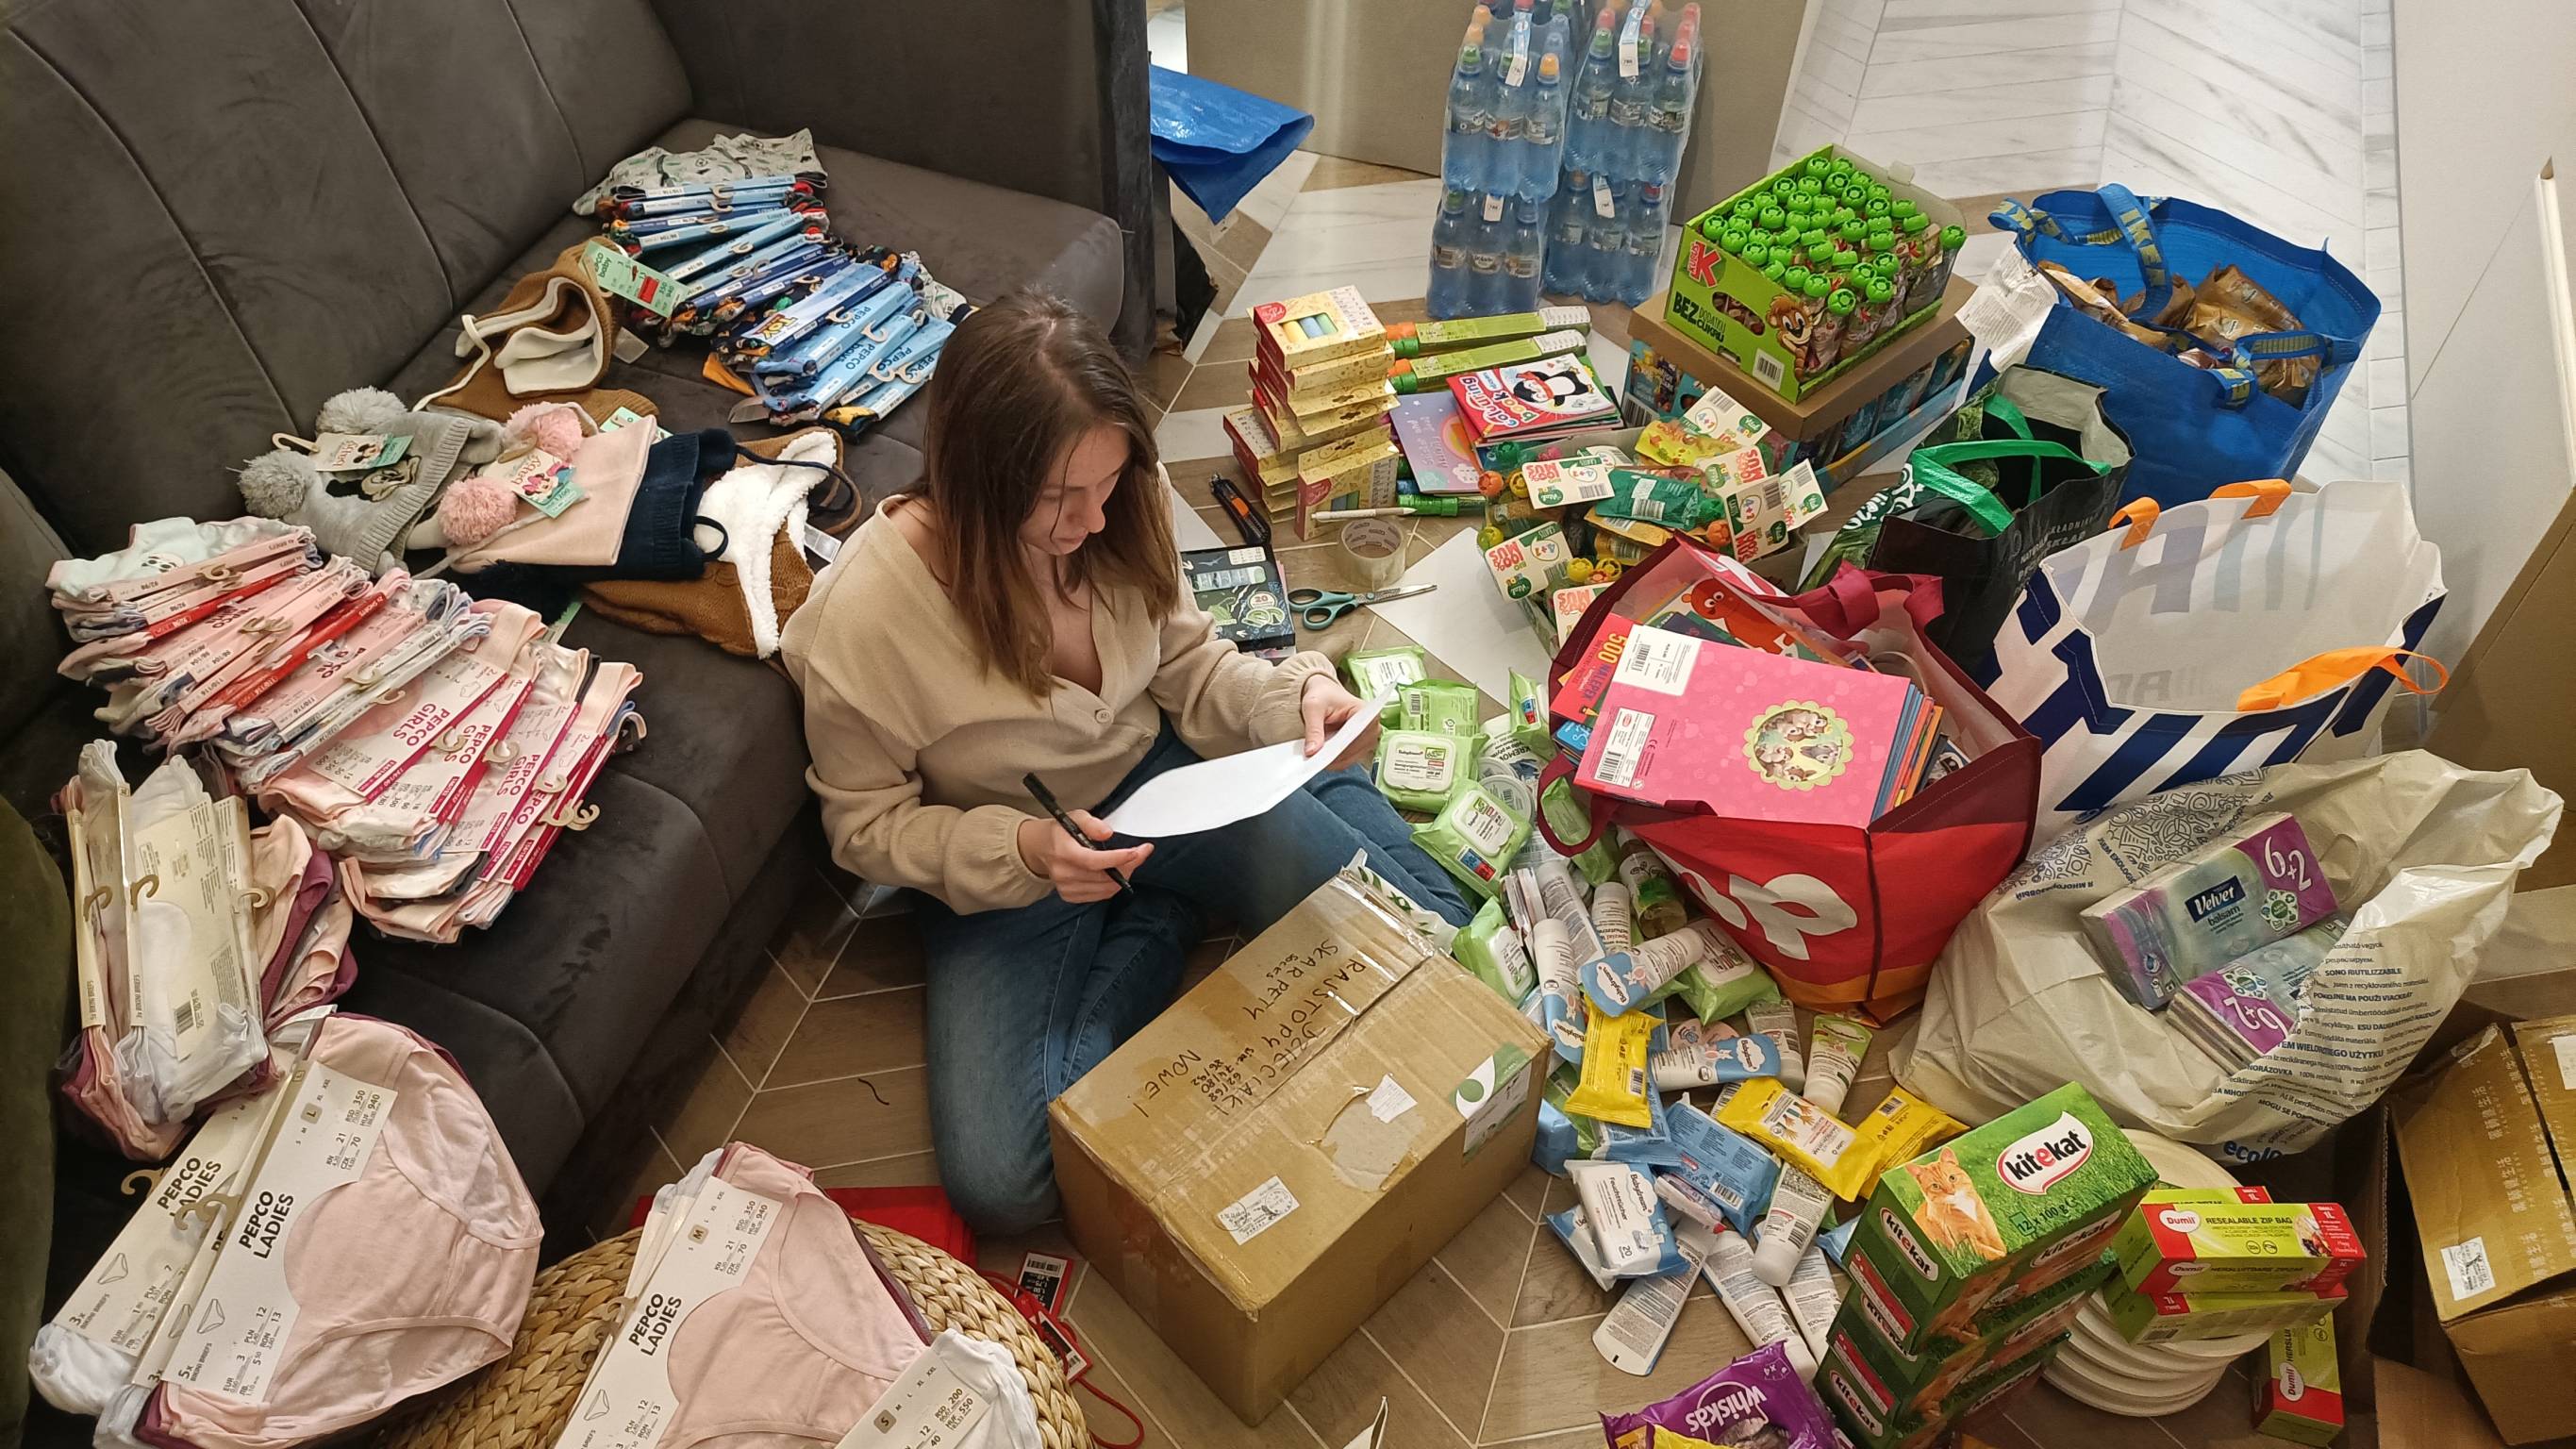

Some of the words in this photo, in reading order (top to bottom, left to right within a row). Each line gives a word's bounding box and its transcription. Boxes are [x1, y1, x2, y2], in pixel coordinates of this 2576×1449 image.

[1690, 241, 1721, 288] K
[1672, 291, 1699, 325] BEZ
[845, 343, 875, 370] PEPCO
[1461, 375, 1520, 427] colouring
[1492, 390, 1539, 423] book
[1525, 462, 1559, 475] MUS
[1745, 448, 1768, 483] MUS
[1487, 541, 1524, 561] MUS
[1735, 535, 1751, 564] MUS
[1597, 633, 1629, 664] 500
[392, 703, 440, 741] GIRLS
[406, 708, 450, 749] PEPCO
[458, 724, 492, 766] PEPCO
[495, 756, 527, 798] GIRLS
[510, 754, 541, 797] PEPCO
[2194, 886, 2235, 915] Velvet
[2207, 905, 2241, 926] balsam
[1602, 966, 1627, 1004] Babydream
[1261, 958, 1367, 1049] RAJSTOPY
[2349, 1049, 2385, 1059] UŻYTKU
[353, 1090, 366, 1106] 350
[367, 1093, 381, 1109] 940
[336, 1133, 347, 1144] 21
[350, 1136, 362, 1148] 70
[2005, 1129, 2086, 1181] kitekat
[157, 1157, 201, 1209] PEPCO
[1630, 1174, 1648, 1211] Babydream
[239, 1191, 274, 1249] PEPCO
[743, 1200, 756, 1215] 350
[756, 1204, 769, 1220] 940
[2017, 1220, 2033, 1235] 12
[2039, 1208, 2060, 1224] 100
[2166, 1216, 2196, 1225] Dumil
[253, 1192, 294, 1259] LADIES
[737, 1243, 748, 1255] 70
[1621, 1244, 1633, 1257] 20
[1886, 1214, 1933, 1277] kitekat
[256, 1306, 267, 1319] 12
[271, 1310, 282, 1323] 13
[628, 1293, 664, 1347] PEPCO
[640, 1296, 682, 1357] LADIES
[244, 1329, 257, 1343] PLN
[177, 1365, 194, 1380] 5x
[638, 1399, 649, 1410] 12
[650, 1404, 662, 1416] 13
[947, 1388, 964, 1406] 200
[957, 1397, 975, 1416] 550
[1685, 1386, 1769, 1434] whiskas
[1836, 1377, 1876, 1433] kitekat
[919, 1424, 932, 1437] 12
[930, 1435, 941, 1447] 40
